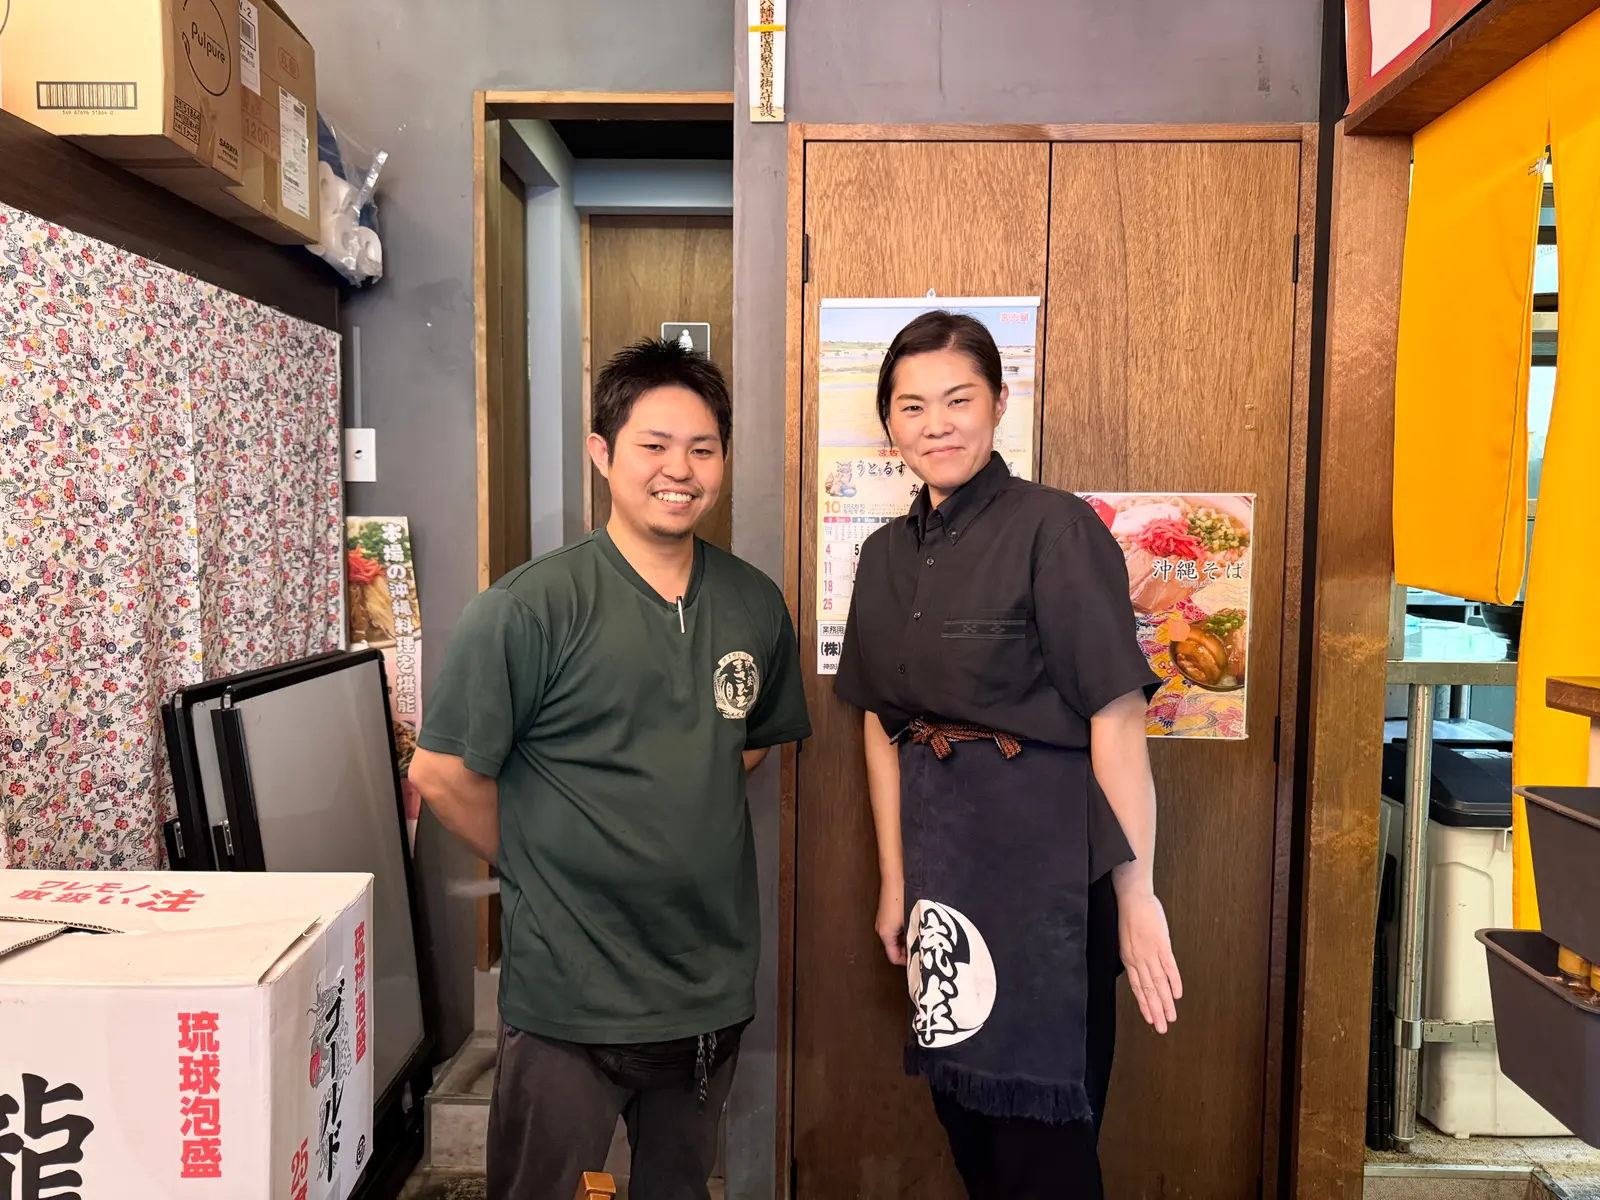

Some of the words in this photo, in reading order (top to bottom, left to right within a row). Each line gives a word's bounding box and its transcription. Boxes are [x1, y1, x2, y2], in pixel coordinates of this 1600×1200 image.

[191, 21, 226, 64] Pulpure
[245, 118, 271, 149] 1200
[824, 500, 842, 515] 10
[825, 543, 832, 556] 4
[854, 543, 860, 556] 5
[824, 561, 832, 574] 11
[1152, 559, 1245, 581] 沖縄そば
[824, 579, 833, 592] 18
[823, 598, 833, 611] 25
[37, 880, 151, 894] ワレモノ
[10, 889, 130, 905] 取扱い
[135, 888, 206, 913] 注
[320, 977, 346, 1183] ゴールド
[177, 1010, 223, 1179] 琉球泡盛
